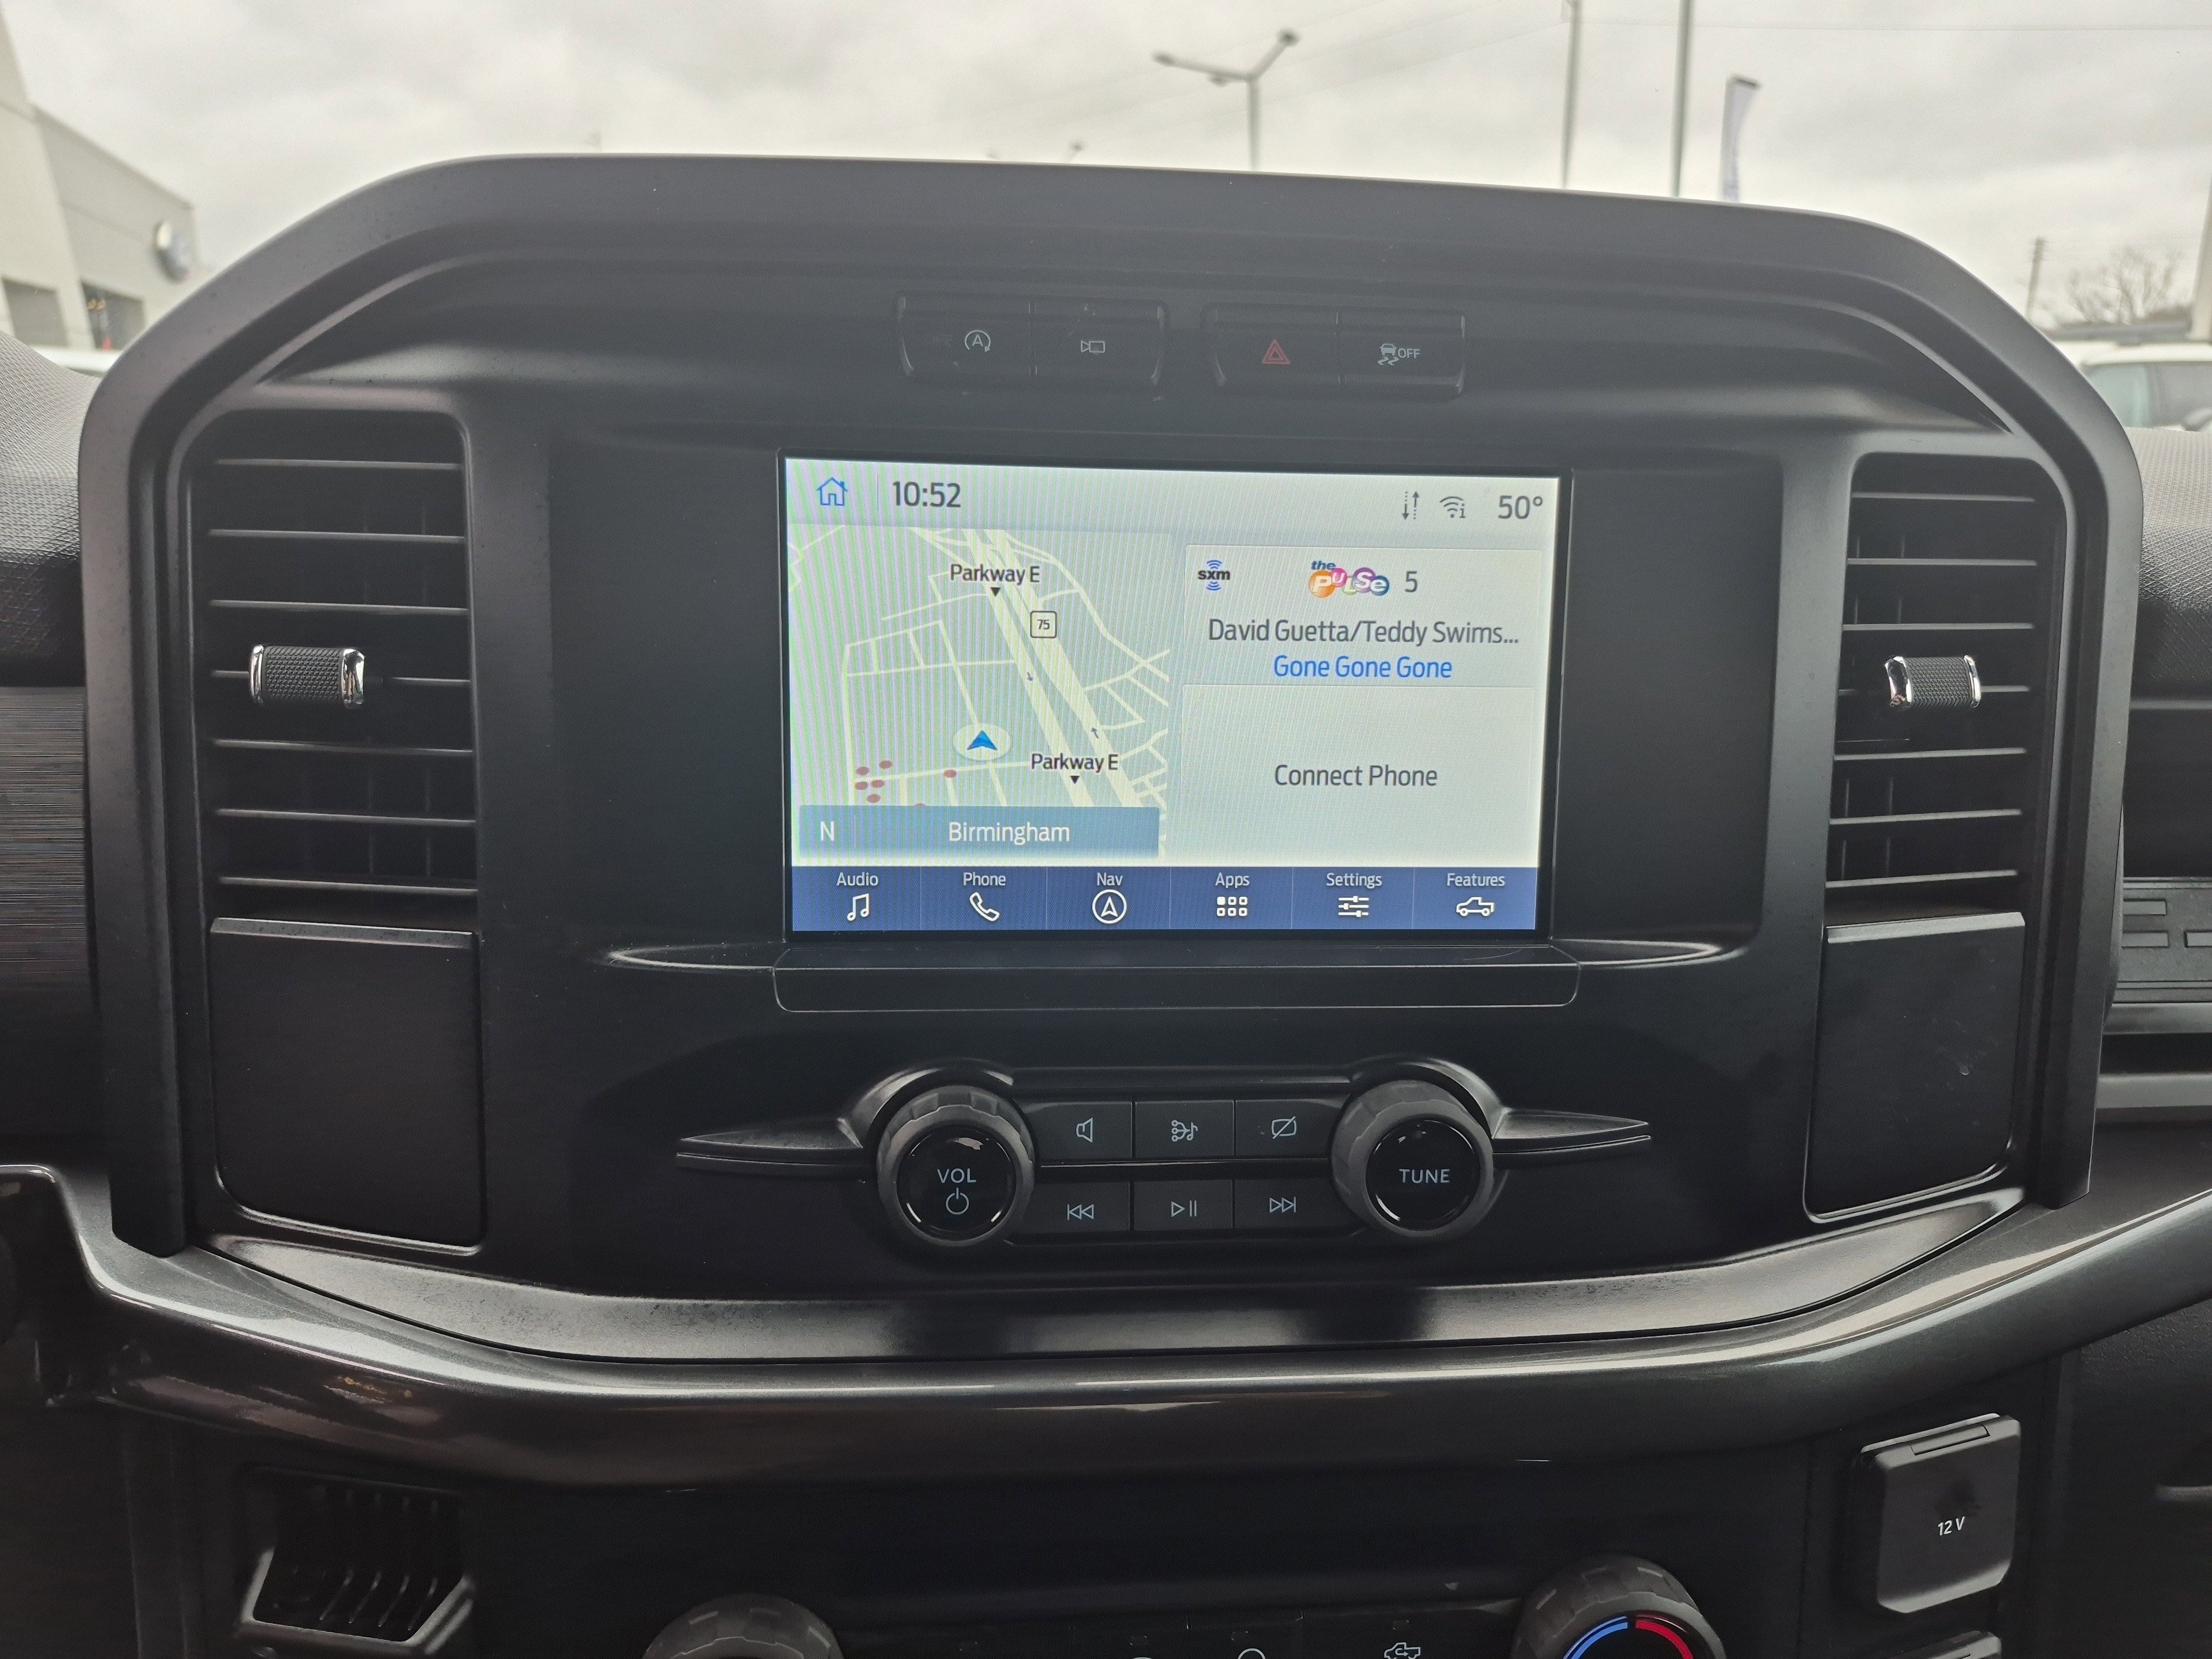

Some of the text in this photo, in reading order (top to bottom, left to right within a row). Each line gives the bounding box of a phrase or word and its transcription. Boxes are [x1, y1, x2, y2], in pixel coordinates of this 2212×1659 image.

[1398, 348, 1420, 359] OFF
[892, 480, 961, 509] 10:52
[1497, 494, 1544, 520] 50°
[1311, 560, 1336, 570] the
[950, 563, 1040, 586] Parkway E
[1197, 568, 1231, 581] sxm
[1404, 570, 1418, 593] 5
[1037, 619, 1050, 631] 75
[1208, 618, 1519, 647] David Guetta/Teddy Swims...
[1274, 654, 1453, 679] Gone Gone Gone
[1031, 753, 1118, 774] Parkway E
[1275, 764, 1438, 787] Connect Phone
[820, 821, 835, 841] N
[948, 821, 1070, 846] Birmingham
[836, 872, 879, 886] Audio
[963, 872, 1006, 886] Phone
[1096, 872, 1123, 886] Nav
[1215, 872, 1250, 888] Apps
[1326, 873, 1382, 889] Settings
[1446, 873, 1506, 888] Features
[937, 1168, 977, 1184] VOL
[1399, 1168, 1451, 1184] TUNE
[1937, 1516, 1965, 1536] 12 V
